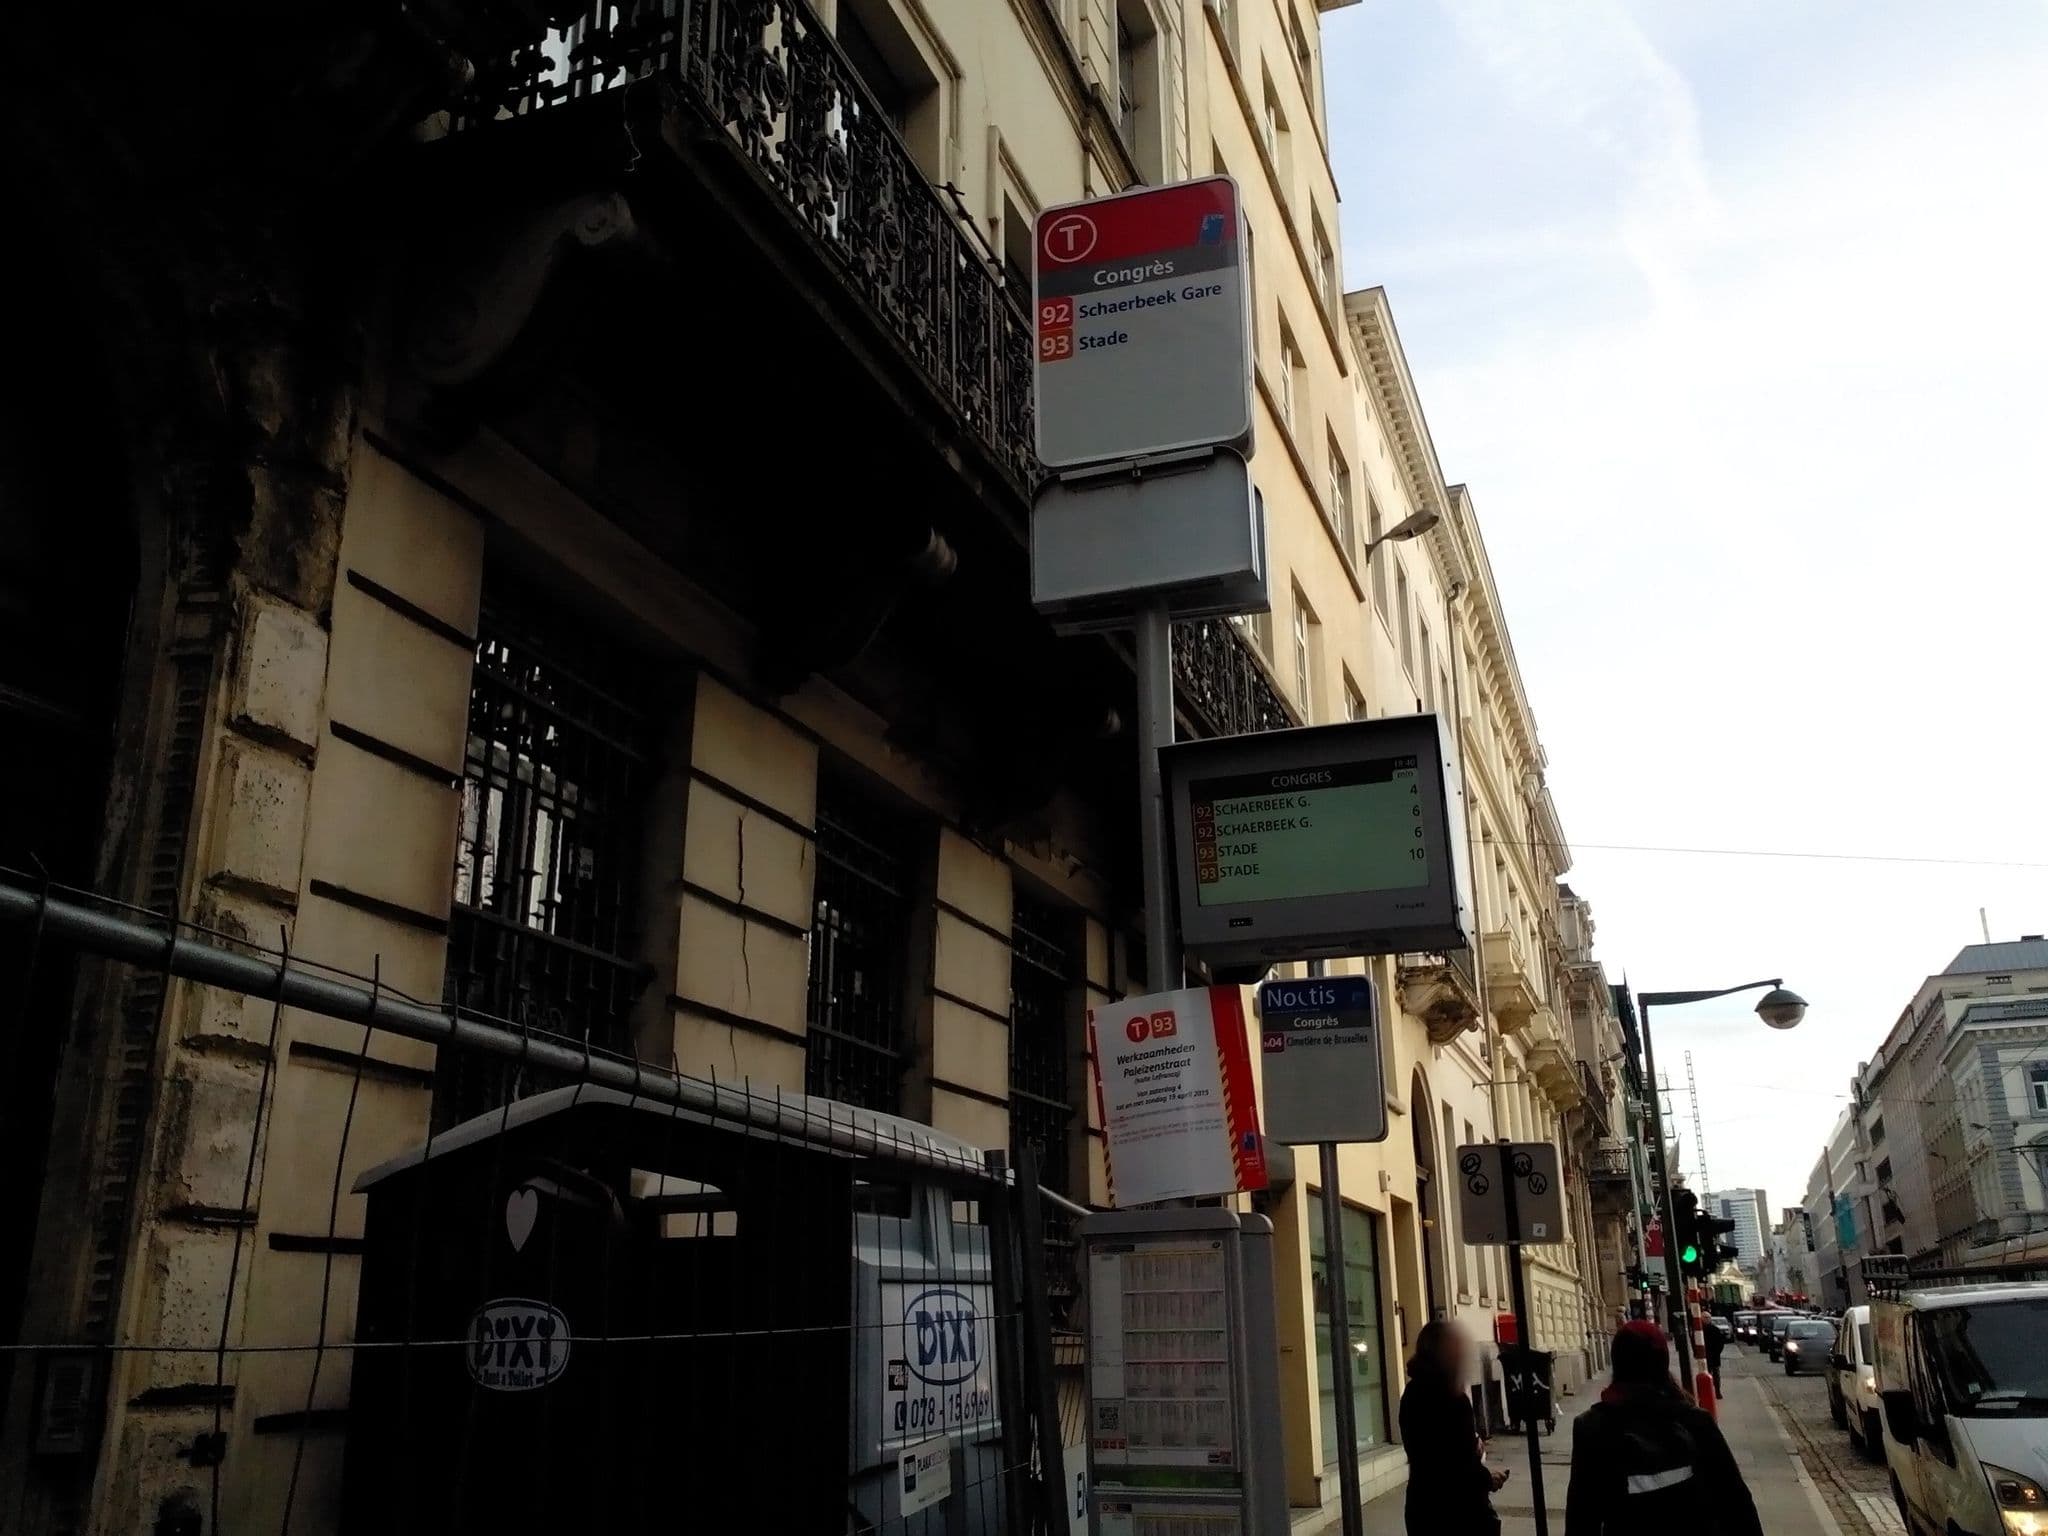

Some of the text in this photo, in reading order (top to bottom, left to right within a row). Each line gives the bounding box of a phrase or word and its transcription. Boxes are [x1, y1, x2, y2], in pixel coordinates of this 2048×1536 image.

[1093, 259, 1175, 286] Congrès
[1042, 282, 1222, 326] 92 Schaerbeek Gare
[1041, 330, 1128, 357] 93 Stade
[1271, 770, 1332, 788] CONGRES
[1197, 784, 1417, 818] 92 SCHAERBEEK G. 4
[1198, 805, 1420, 838] 92 SCHAERBEEK G. 6
[1199, 827, 1422, 859] 93 STADE 6
[1200, 848, 1424, 880] 93 STADE 10
[1267, 985, 1336, 1007] Noctis
[1154, 1017, 1173, 1032] 93
[1293, 1016, 1339, 1029] Congrès
[1323, 1035, 1332, 1045] de
[1117, 1044, 1195, 1065] Werkzaamheden
[1123, 1058, 1191, 1078] Paleizenstraat
